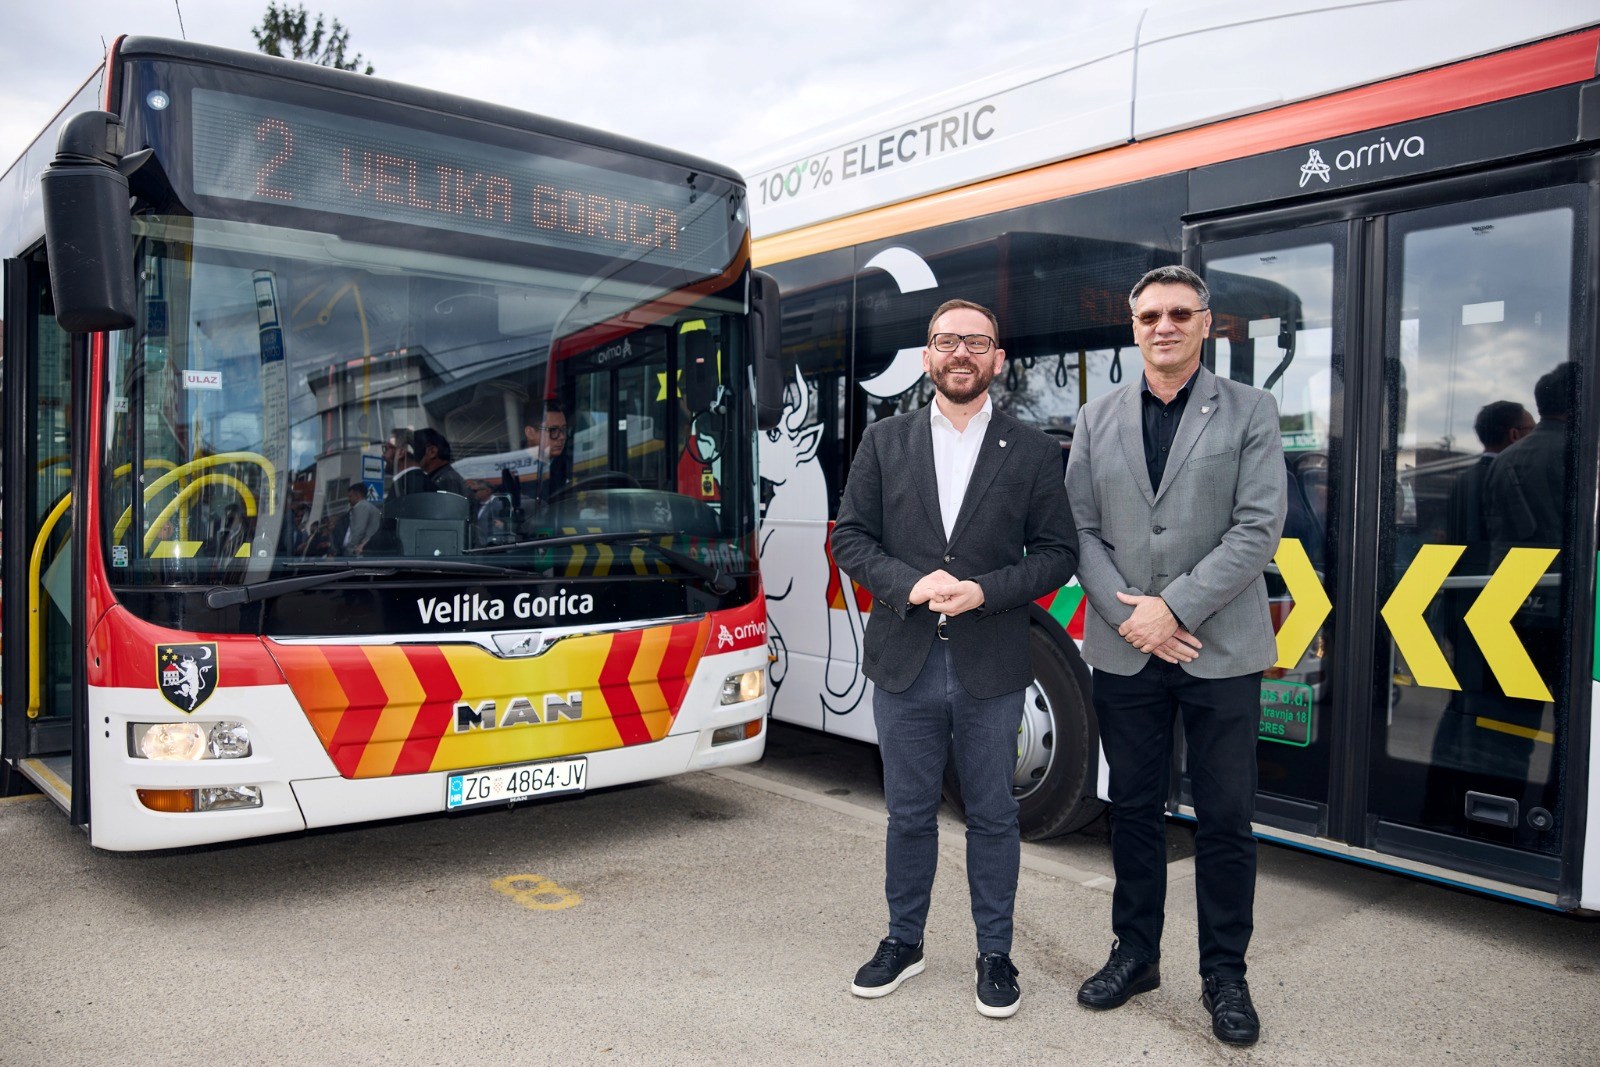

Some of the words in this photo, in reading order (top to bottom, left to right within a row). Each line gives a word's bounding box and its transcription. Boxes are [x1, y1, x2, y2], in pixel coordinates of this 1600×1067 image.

[842, 104, 996, 181] ELECTRIC
[1335, 135, 1425, 171] arriva
[255, 117, 293, 201] 2
[342, 147, 513, 223] VELIKA
[532, 183, 678, 251] GORICA
[187, 374, 218, 385] ULAZ
[416, 592, 505, 625] Velika
[513, 588, 594, 619] Gorica
[734, 620, 766, 640] arriva
[453, 690, 584, 735] MAN
[1259, 720, 1285, 735] CRES
[1296, 710, 1307, 723] 18
[465, 775, 491, 801] ZG
